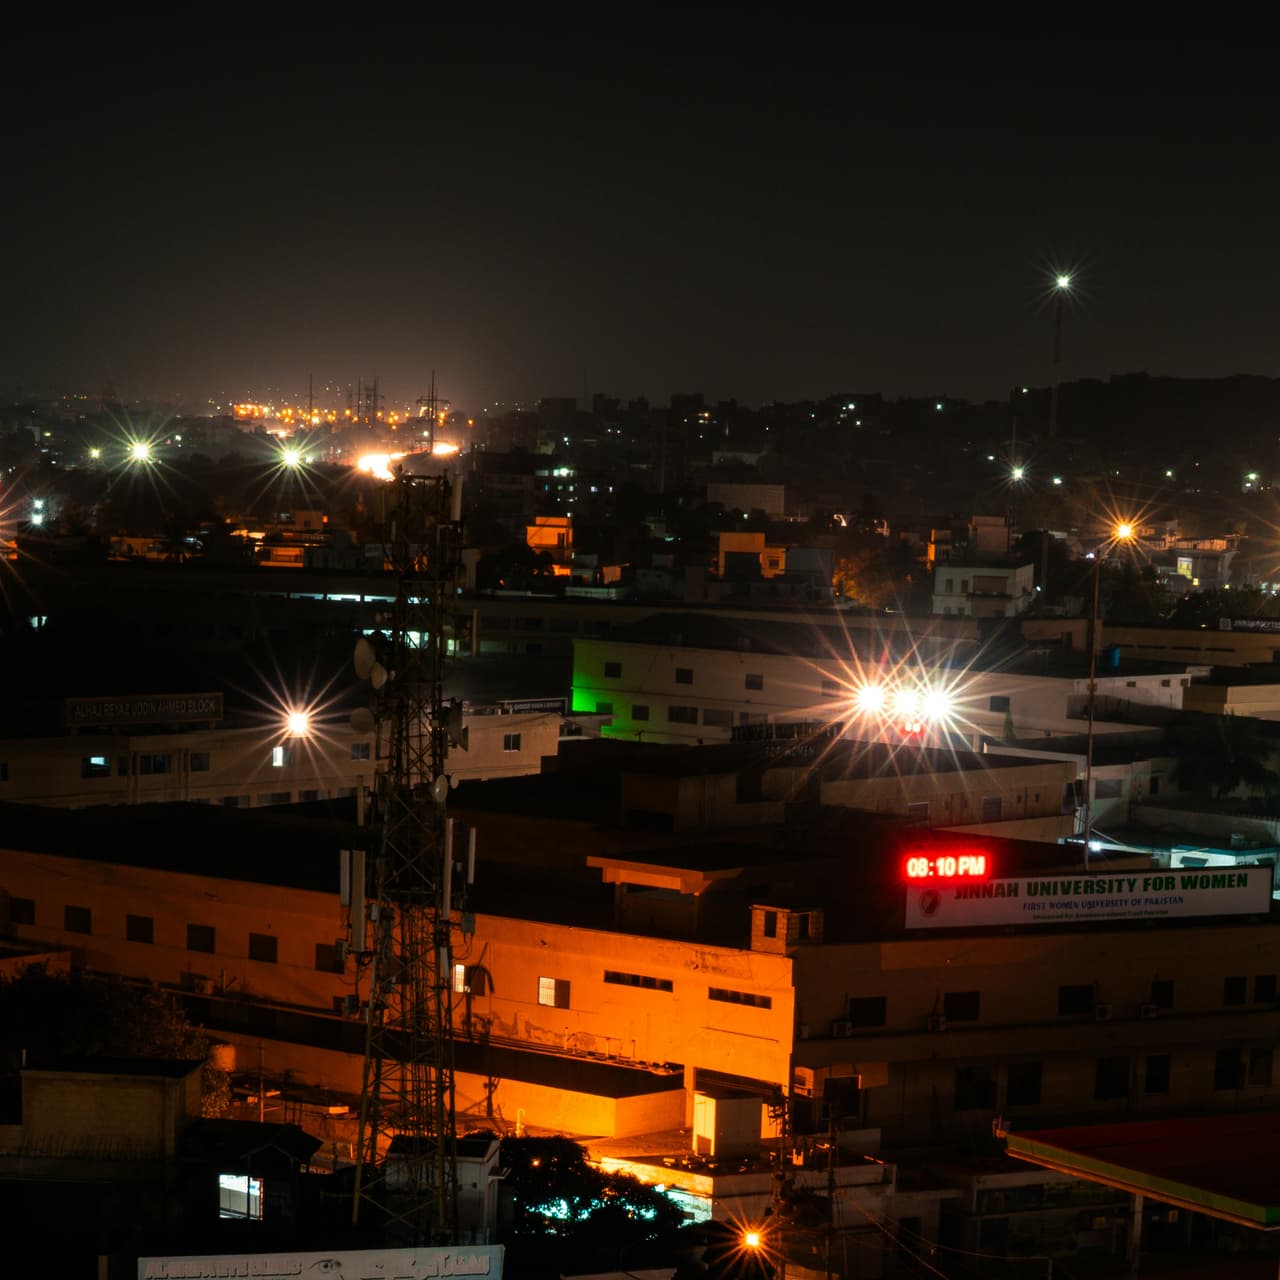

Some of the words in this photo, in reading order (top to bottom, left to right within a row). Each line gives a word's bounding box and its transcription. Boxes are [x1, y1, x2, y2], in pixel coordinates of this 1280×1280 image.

[187, 698, 216, 712] BLOCK
[906, 856, 957, 878] 08:10
[958, 855, 986, 876] PM
[954, 881, 1020, 900] JINNAH
[1026, 878, 1137, 897] UNIVERSITY
[1142, 876, 1176, 893] FOR
[1181, 873, 1249, 891] WOMEN
[1023, 902, 1047, 911] FIRST
[1049, 901, 1079, 910] WOMEN
[1081, 898, 1129, 910] UNIVERSITY
[1131, 897, 1142, 906] OF
[1144, 895, 1185, 905] PAKISTAN
